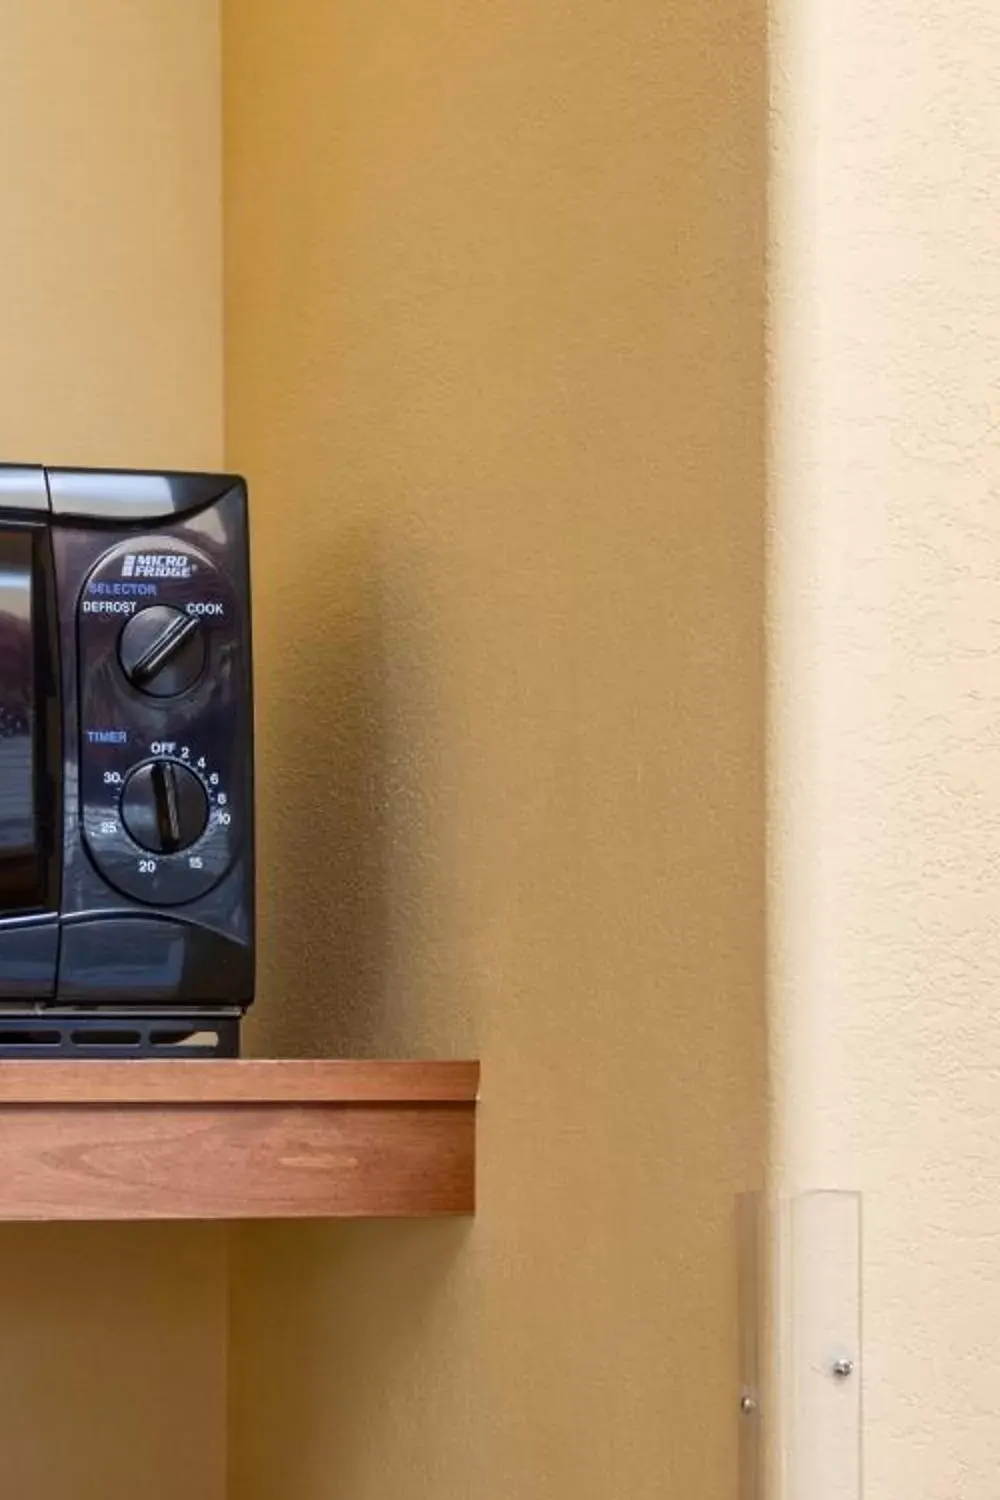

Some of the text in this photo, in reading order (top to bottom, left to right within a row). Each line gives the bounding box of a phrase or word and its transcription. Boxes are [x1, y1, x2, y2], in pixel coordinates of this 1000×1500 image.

[136, 555, 188, 567] MICRO
[134, 565, 191, 578] FRIDGE
[88, 583, 157, 596] SELECTOR
[82, 601, 137, 614] DEFROST
[185, 602, 224, 616] COOK
[87, 730, 127, 743] TIMER
[150, 741, 177, 754] OFF
[182, 747, 190, 758] 2
[198, 757, 206, 768] 4
[103, 771, 121, 784] 30
[210, 774, 219, 785] 6
[218, 793, 227, 804] 8
[216, 812, 231, 825] 10
[101, 822, 117, 834] 25
[138, 860, 157, 873] 20
[189, 857, 203, 869] 15
